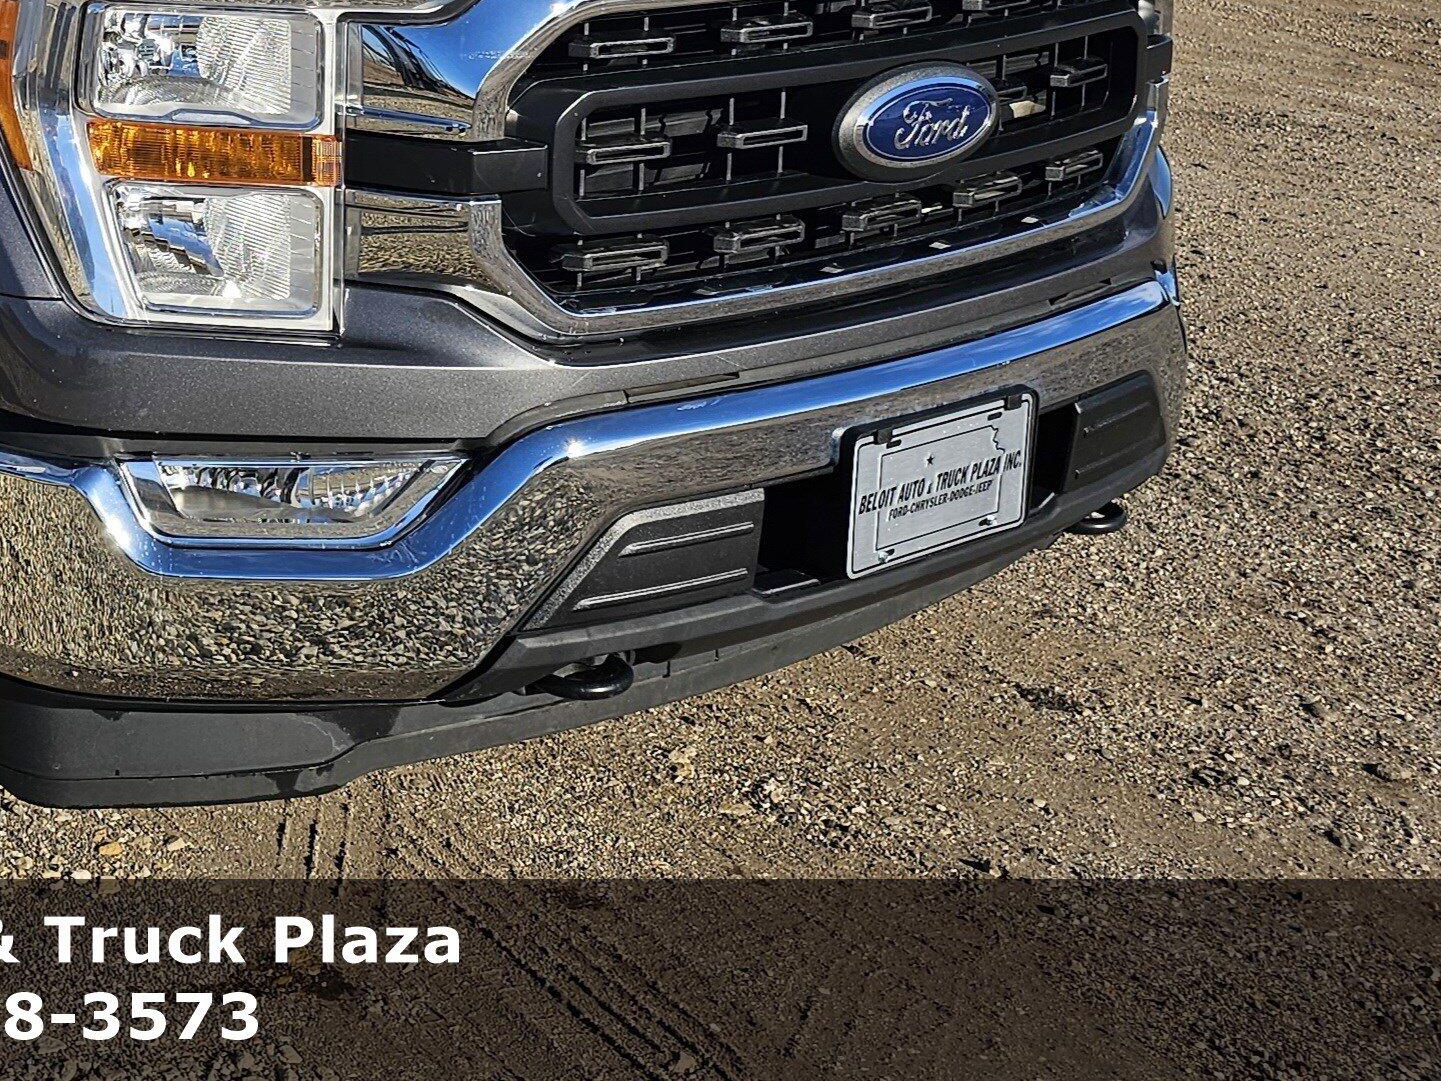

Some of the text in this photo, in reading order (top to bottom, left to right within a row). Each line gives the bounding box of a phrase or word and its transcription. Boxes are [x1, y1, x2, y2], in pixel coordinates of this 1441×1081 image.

[894, 98, 970, 150] Ford
[859, 485, 897, 515] BELOIT
[897, 477, 926, 504] AUTO
[935, 464, 970, 492] TRUCK
[969, 455, 1002, 483] PLAZA
[1003, 449, 1022, 471] INC.
